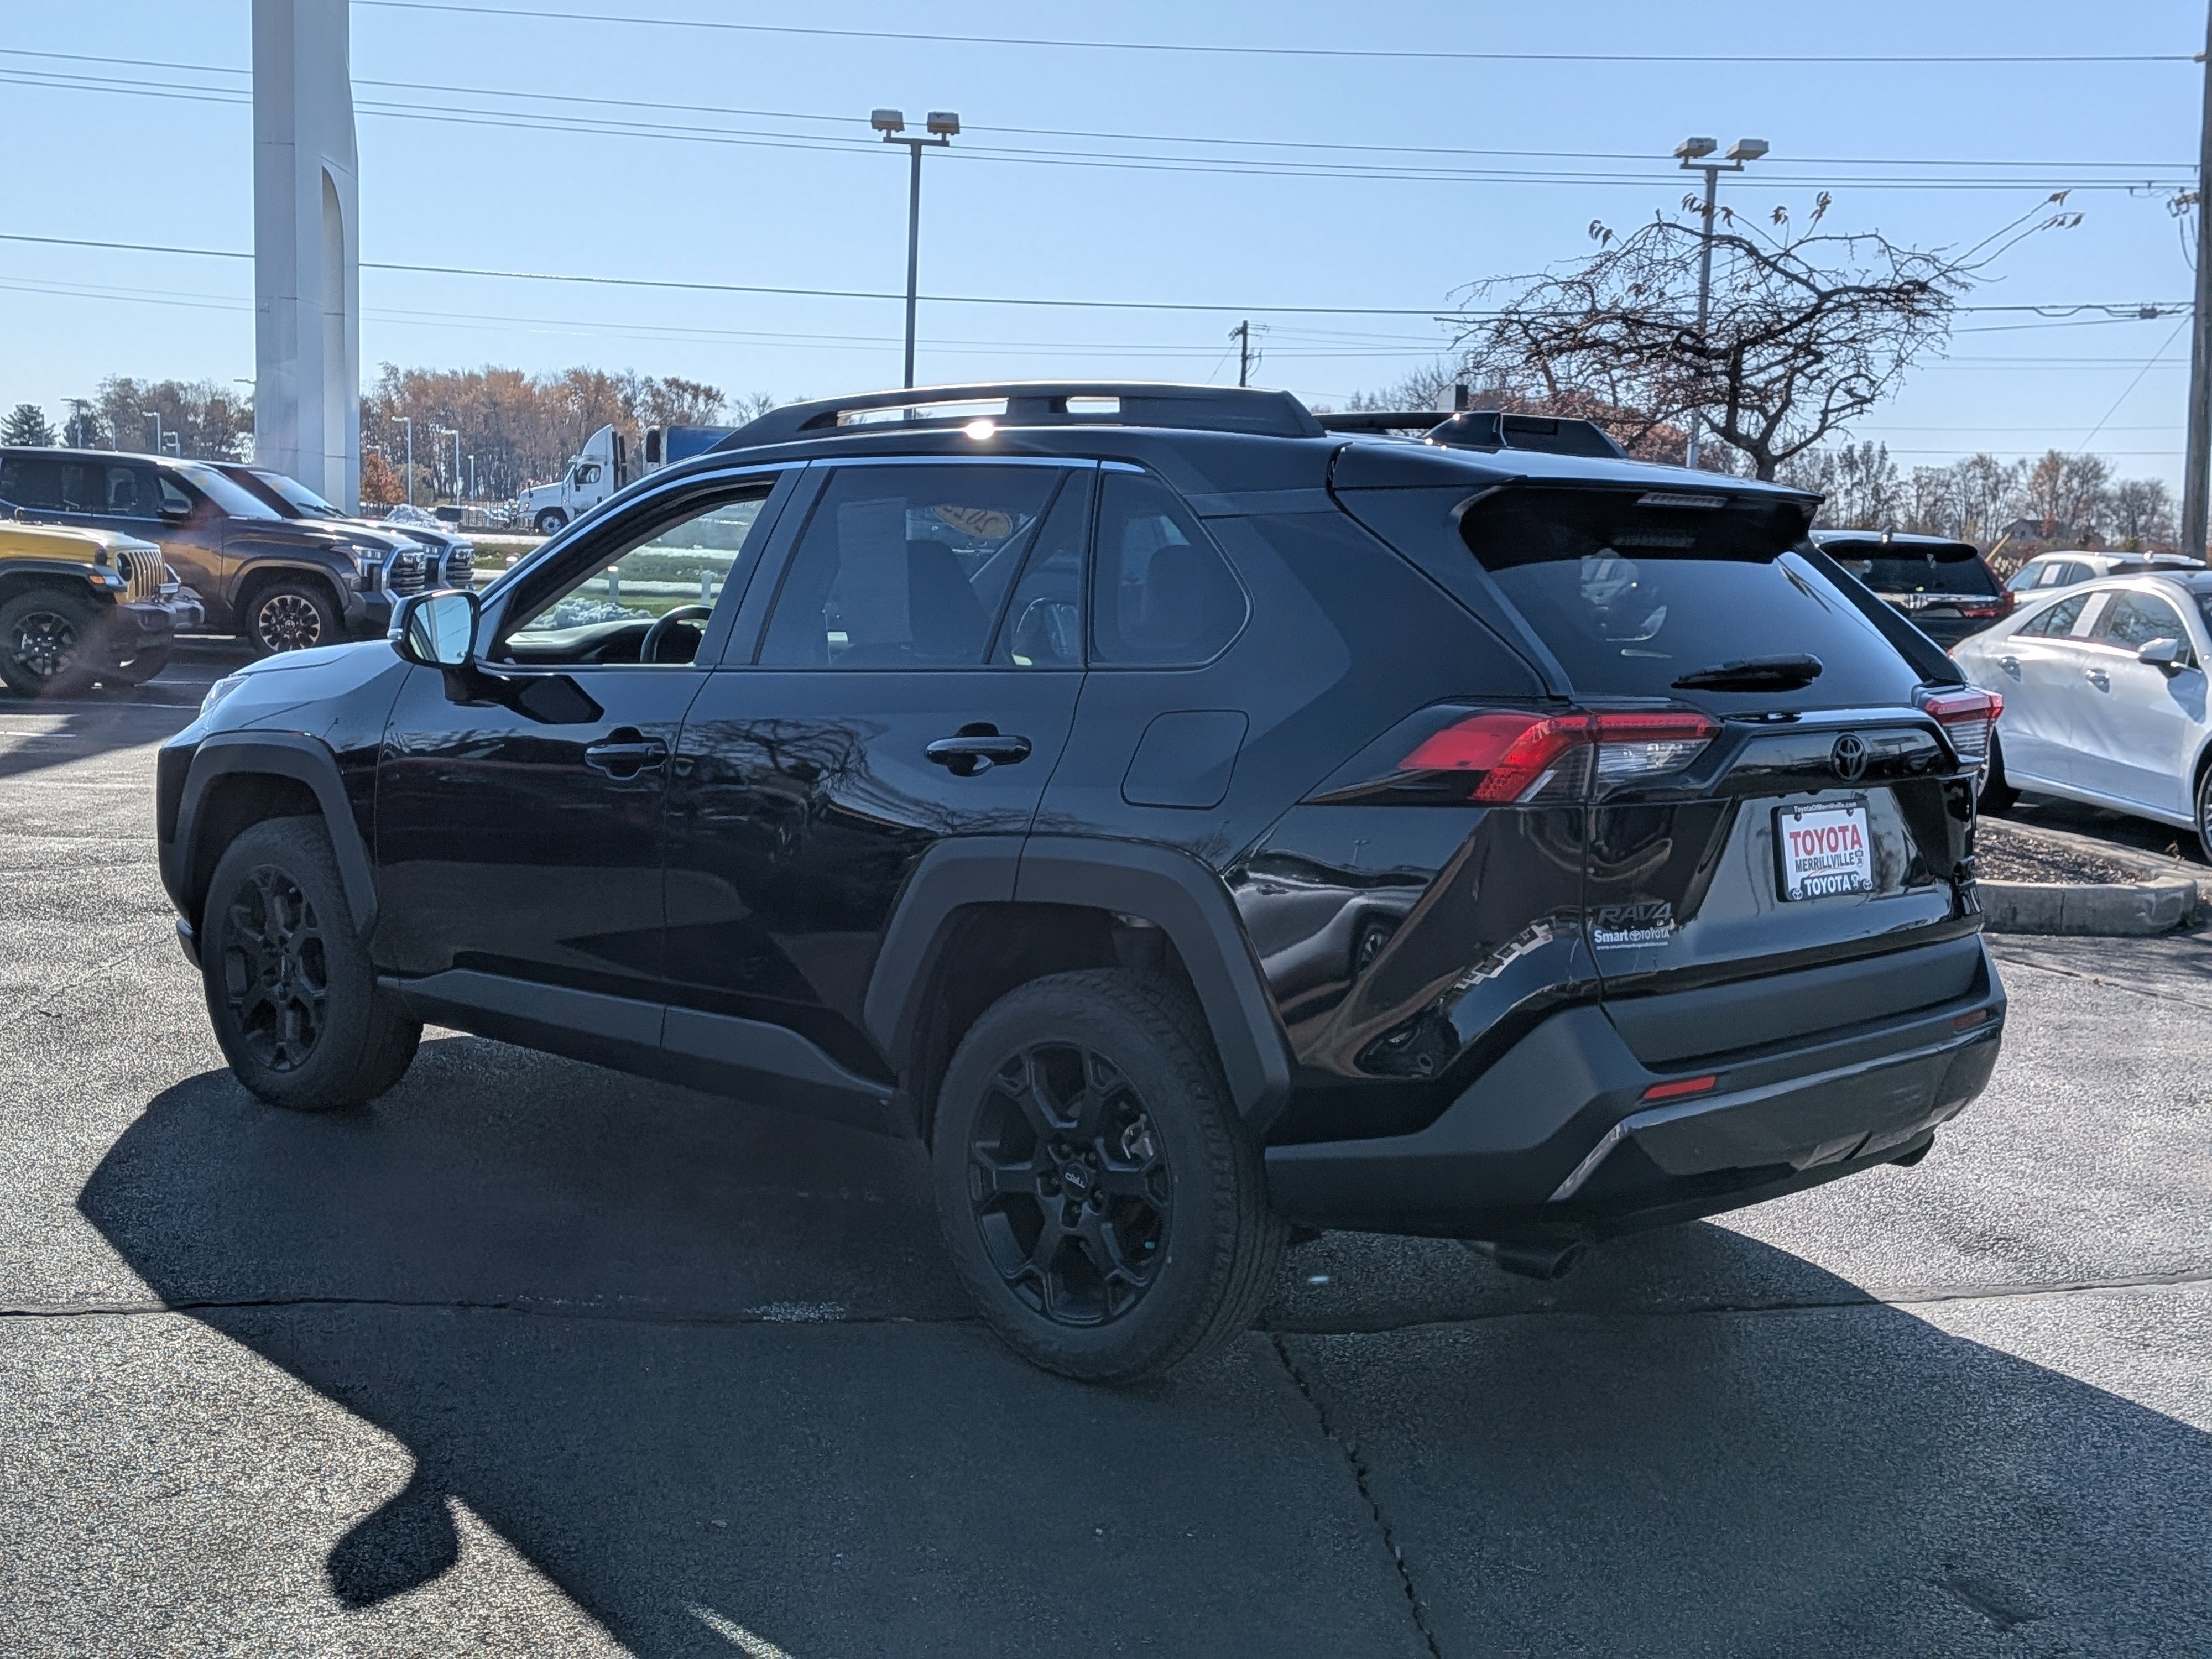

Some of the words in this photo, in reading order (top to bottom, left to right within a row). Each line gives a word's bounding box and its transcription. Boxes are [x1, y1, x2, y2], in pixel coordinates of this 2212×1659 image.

[1790, 824, 1863, 857] TOYOTA
[1795, 852, 1855, 873] MERRILLVILLE
[1804, 874, 1851, 896] TOYOTA
[1597, 902, 1672, 925] RAV4
[1594, 929, 1629, 943] Smart
[1641, 928, 1670, 940] TOYOTA
